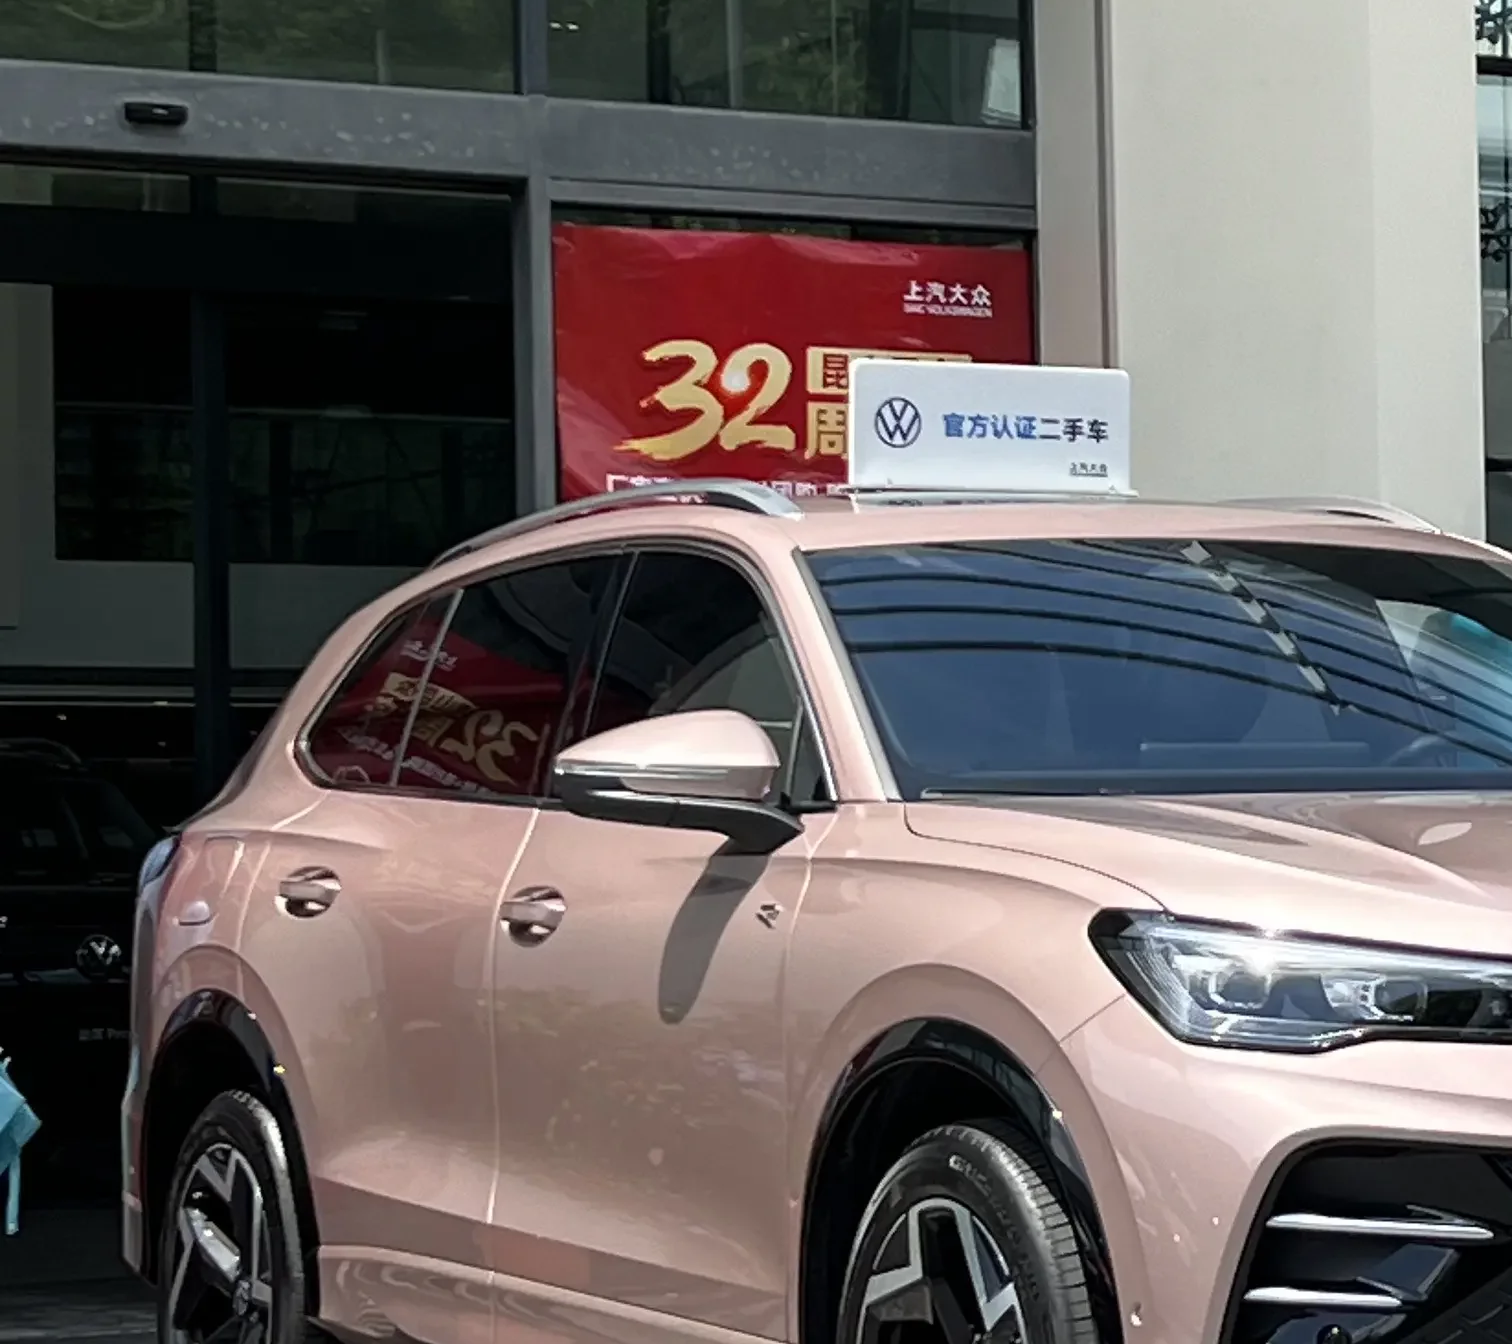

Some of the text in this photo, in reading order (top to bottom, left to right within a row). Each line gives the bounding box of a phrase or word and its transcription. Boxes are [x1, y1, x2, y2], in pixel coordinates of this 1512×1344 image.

[902, 279, 993, 307] 上汽大众
[613, 339, 796, 460] 32
[941, 411, 1109, 444] 官方认证二手车
